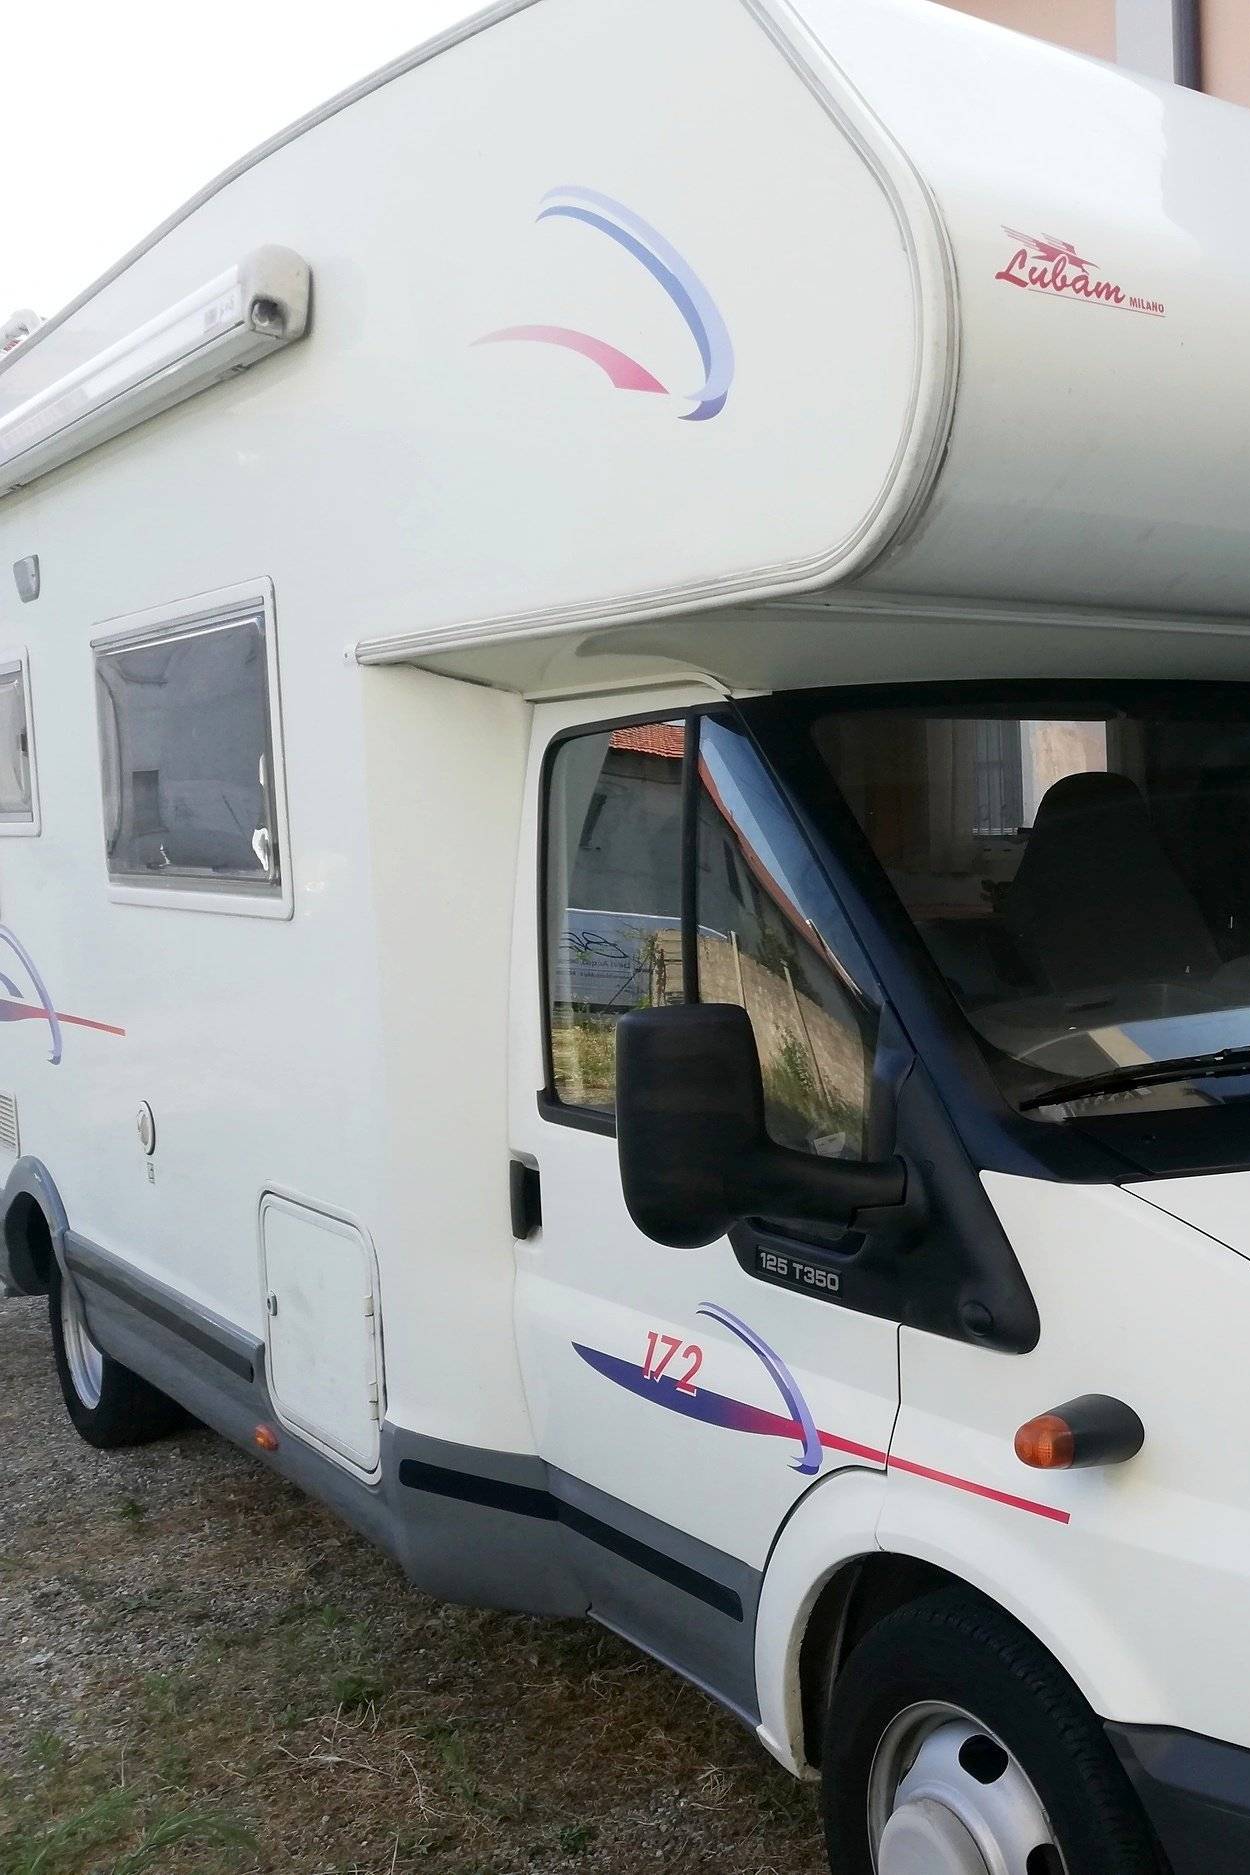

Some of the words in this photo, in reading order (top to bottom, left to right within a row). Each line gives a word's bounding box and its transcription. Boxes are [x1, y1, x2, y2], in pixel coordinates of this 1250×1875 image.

[995, 249, 1126, 304] Lubam
[1129, 297, 1165, 313] MILANO
[760, 1252, 788, 1275] 125
[792, 1262, 839, 1291] T350
[642, 1331, 703, 1396] 172
